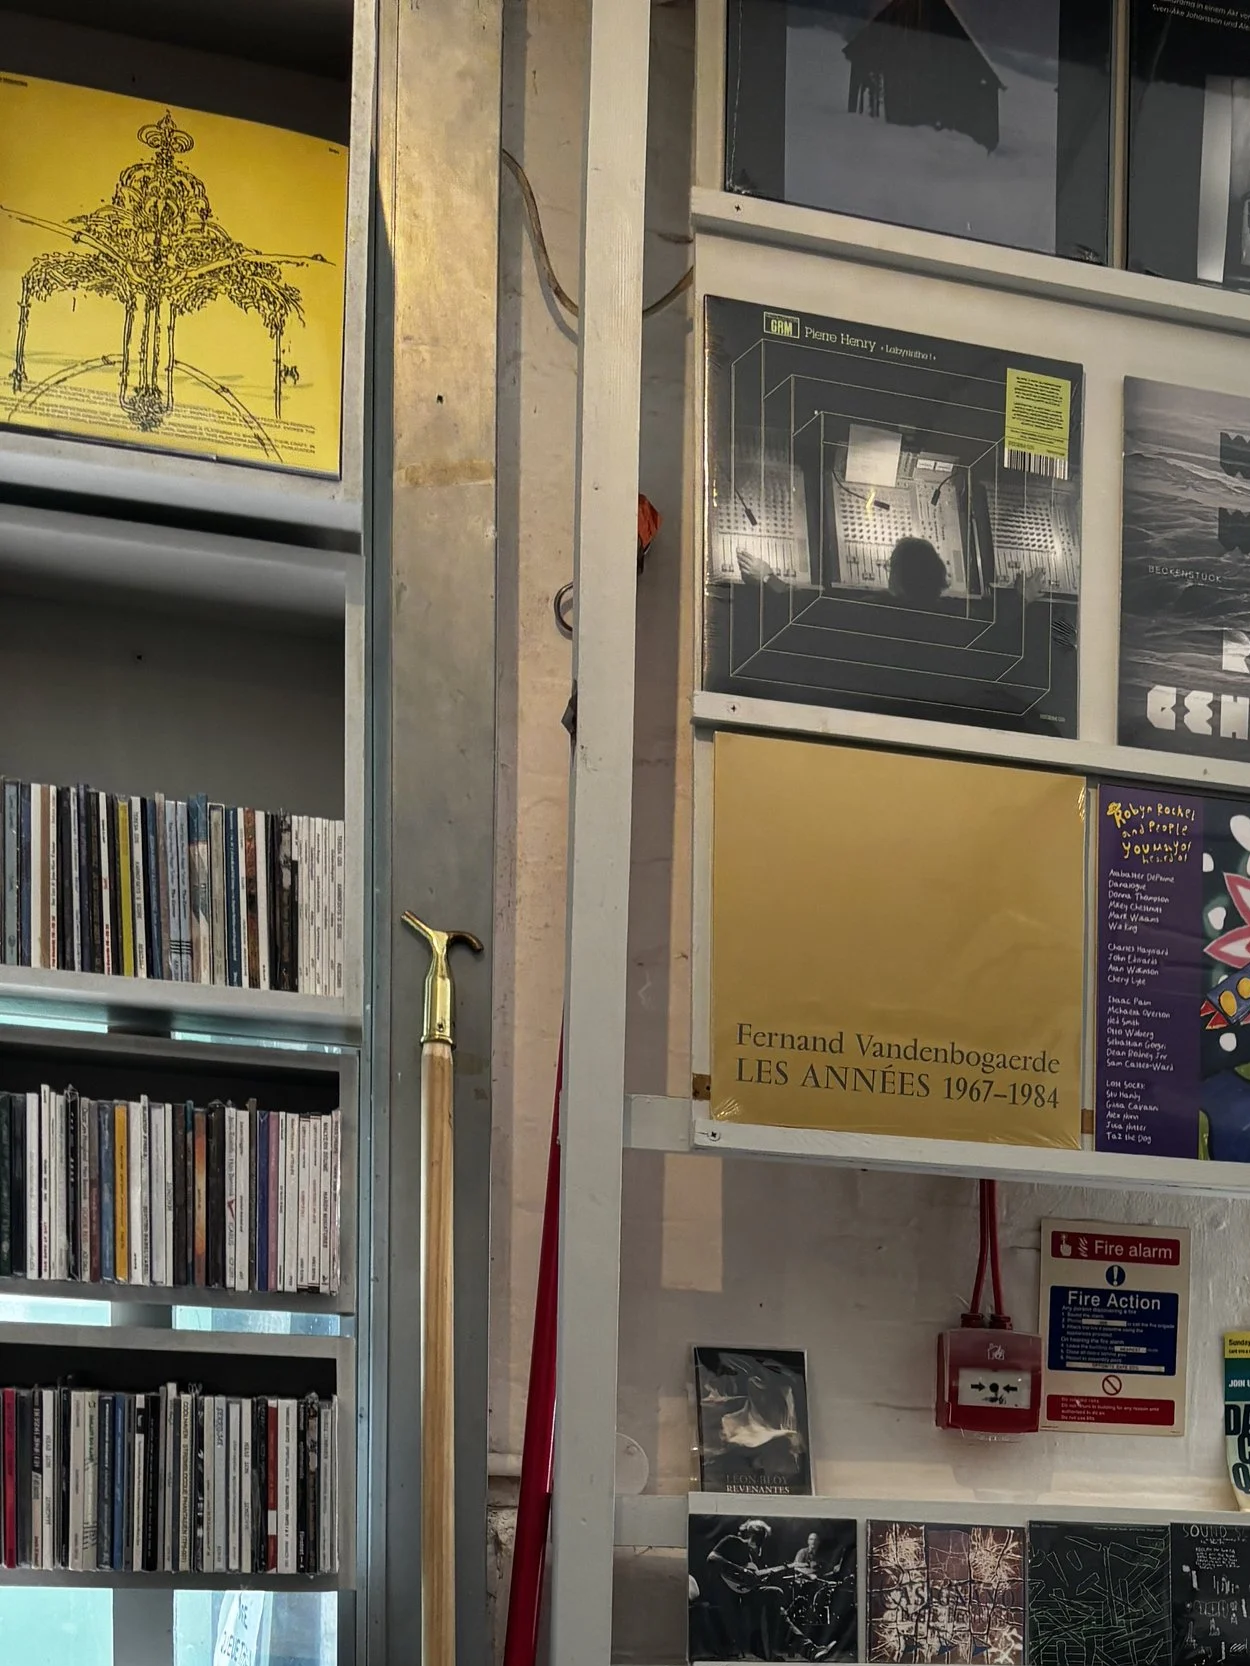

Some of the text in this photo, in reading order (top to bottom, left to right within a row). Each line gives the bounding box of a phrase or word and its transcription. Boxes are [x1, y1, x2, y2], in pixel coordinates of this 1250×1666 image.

[1203, 5, 1226, 15] einem
[1227, 9, 1238, 18] Akt
[1186, 12, 1222, 25] Johansson
[1224, 19, 1238, 29] und
[771, 319, 792, 336] GRM
[805, 326, 837, 342] Pierre
[841, 333, 876, 351] Henry
[1112, 803, 1152, 828] Robyn
[1122, 824, 1144, 838] and
[1122, 842, 1150, 859] you
[1153, 841, 1179, 855] may
[1143, 854, 1187, 864] heard of
[1109, 890, 1169, 903] Donna Thompson
[1108, 943, 1134, 951] Charles
[1108, 953, 1125, 961] John
[736, 1022, 1060, 1074] Fernand Vandenbogaerde
[736, 1058, 788, 1085] LES
[800, 1063, 930, 1098] ANNÉES
[1125, 1133, 1135, 1141] the
[1138, 1135, 1151, 1144] Dog
[1095, 1240, 1172, 1259] Fire alarm
[1068, 1290, 1100, 1307] Fire
[1107, 1293, 1161, 1310] Action
[1229, 1339, 1250, 1347] Sunday
[1229, 1379, 1245, 1387] JOIN
[726, 1485, 790, 1494] REVENANTES
[1183, 1525, 1227, 1538] SOUND
